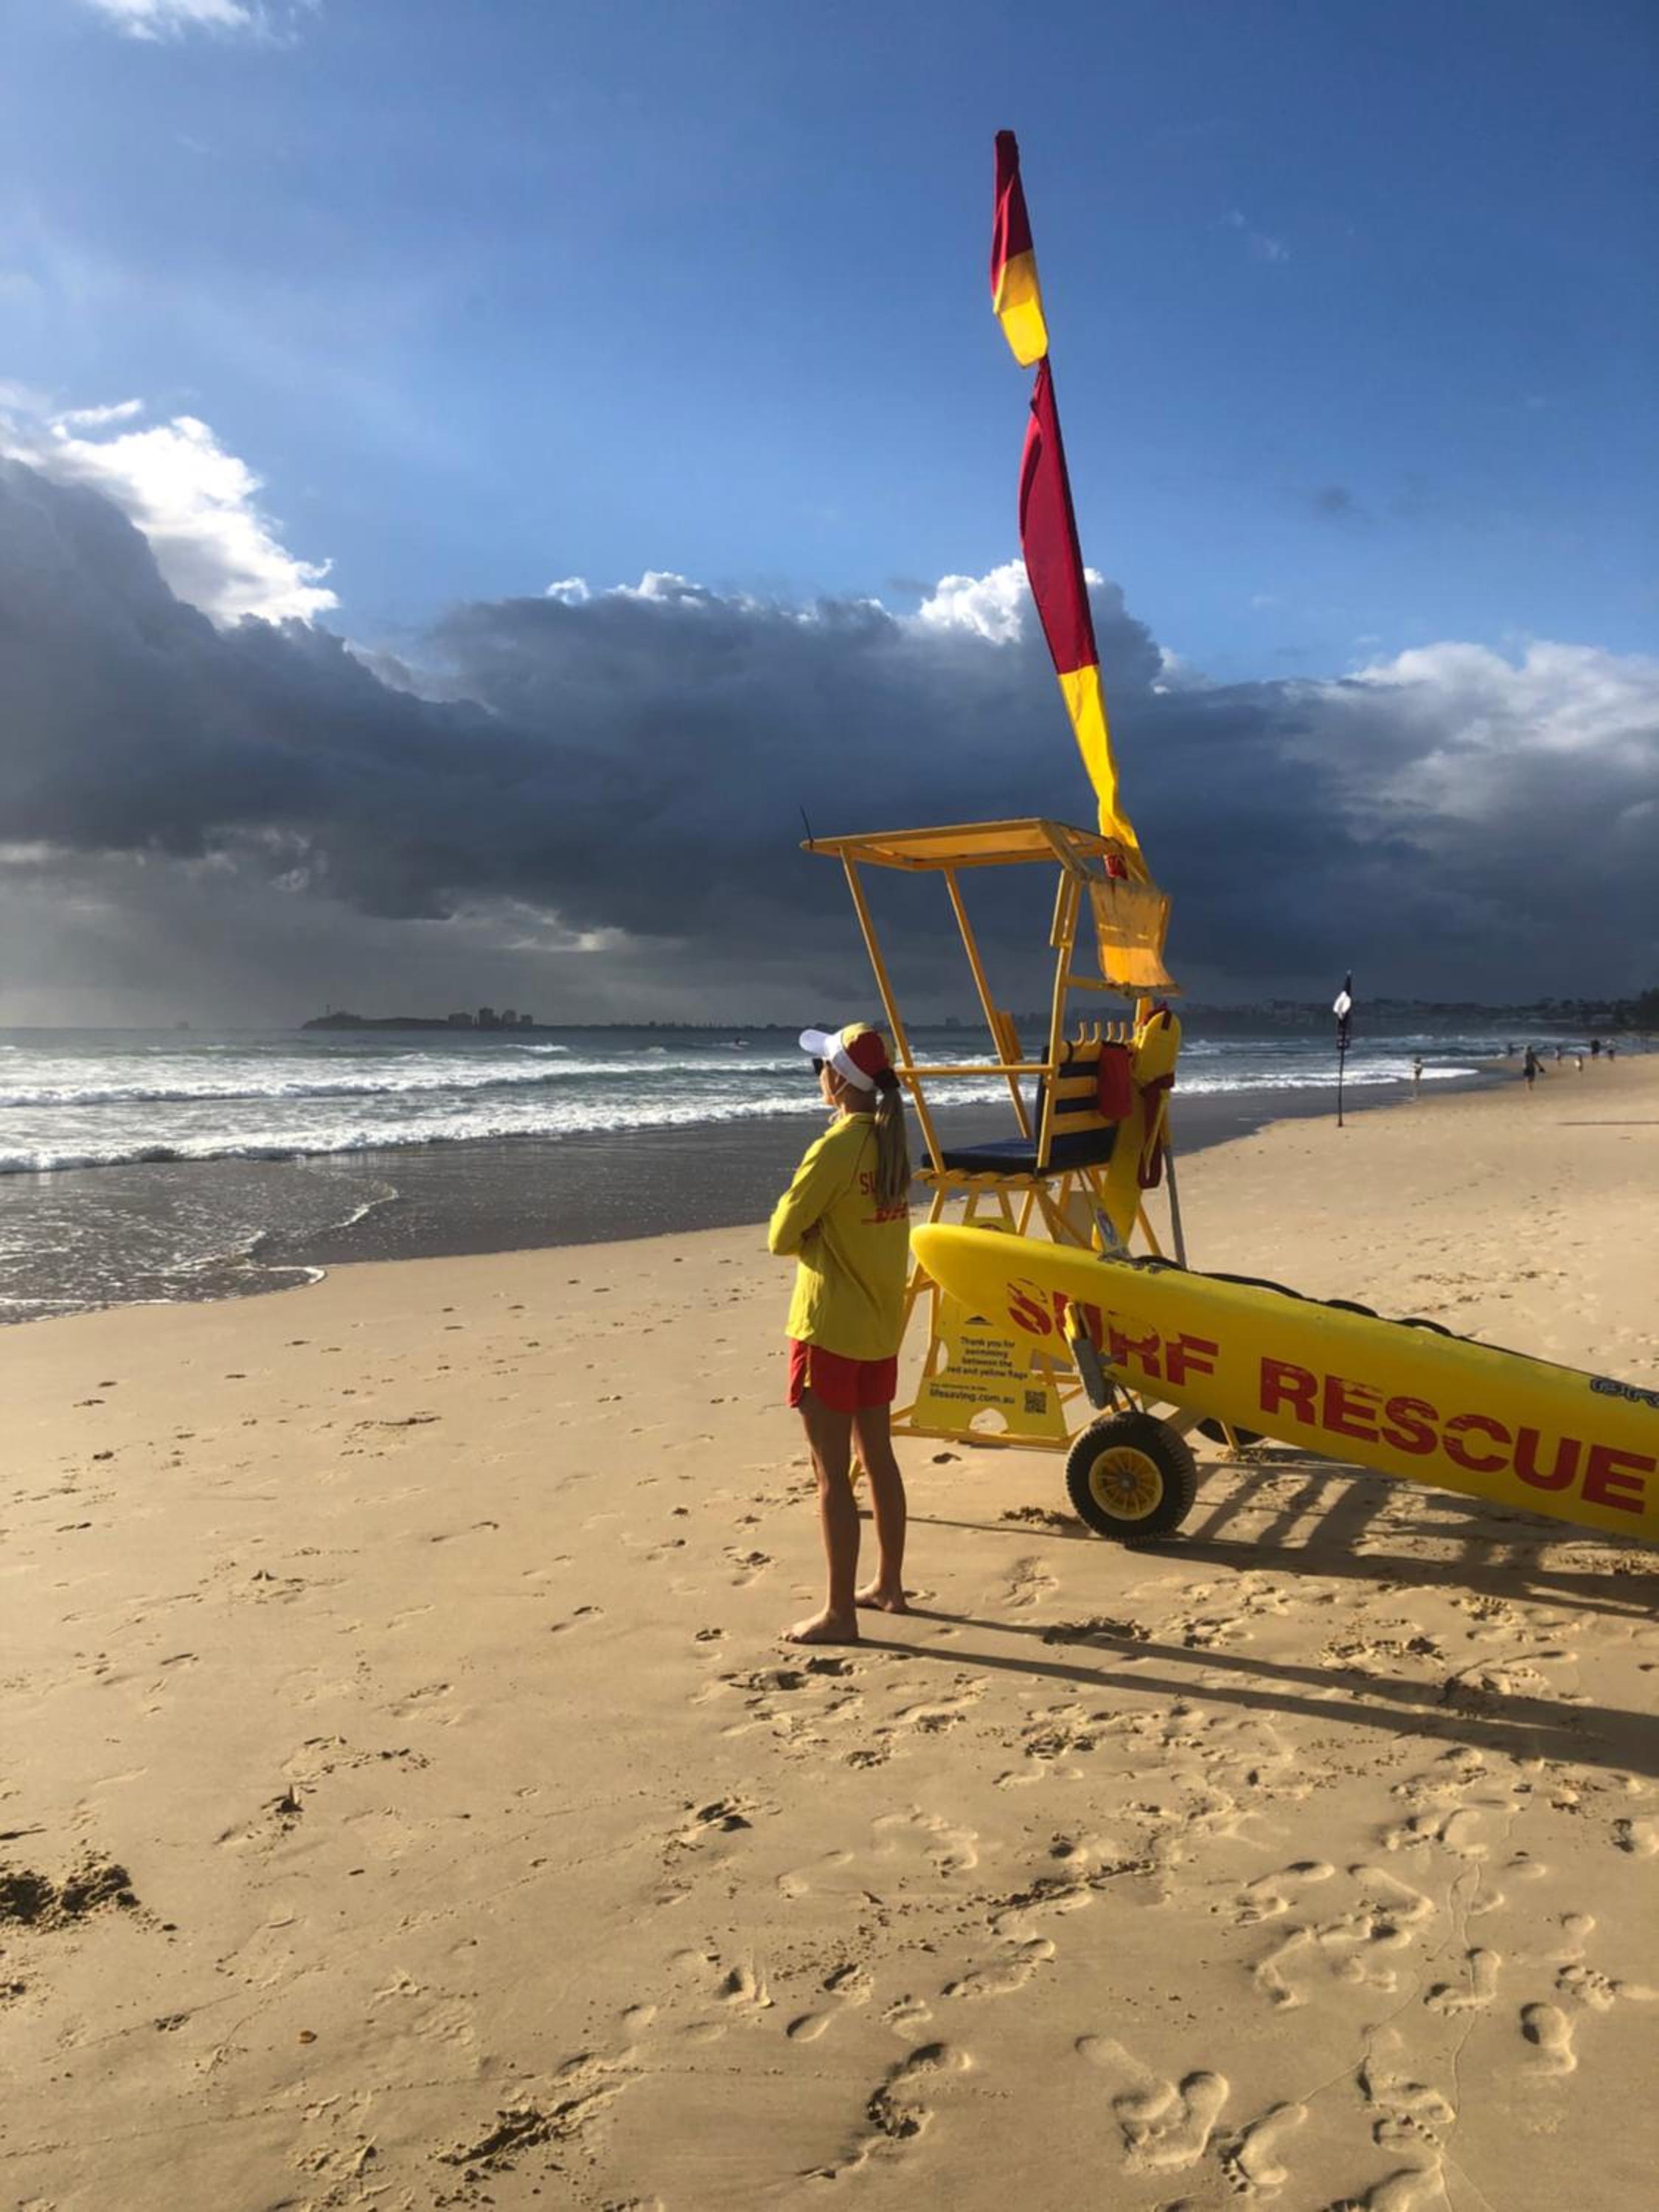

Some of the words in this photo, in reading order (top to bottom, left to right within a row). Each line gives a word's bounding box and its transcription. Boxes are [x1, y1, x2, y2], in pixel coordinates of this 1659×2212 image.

[960, 1335, 984, 1346] Thank
[987, 1340, 1001, 1348] you
[1004, 1339, 1015, 1347] for
[961, 1357, 997, 1366] between
[980, 1369, 1006, 1377] yellow
[1008, 1369, 1028, 1380] flags
[1259, 1357, 1657, 1514] RESCUE
